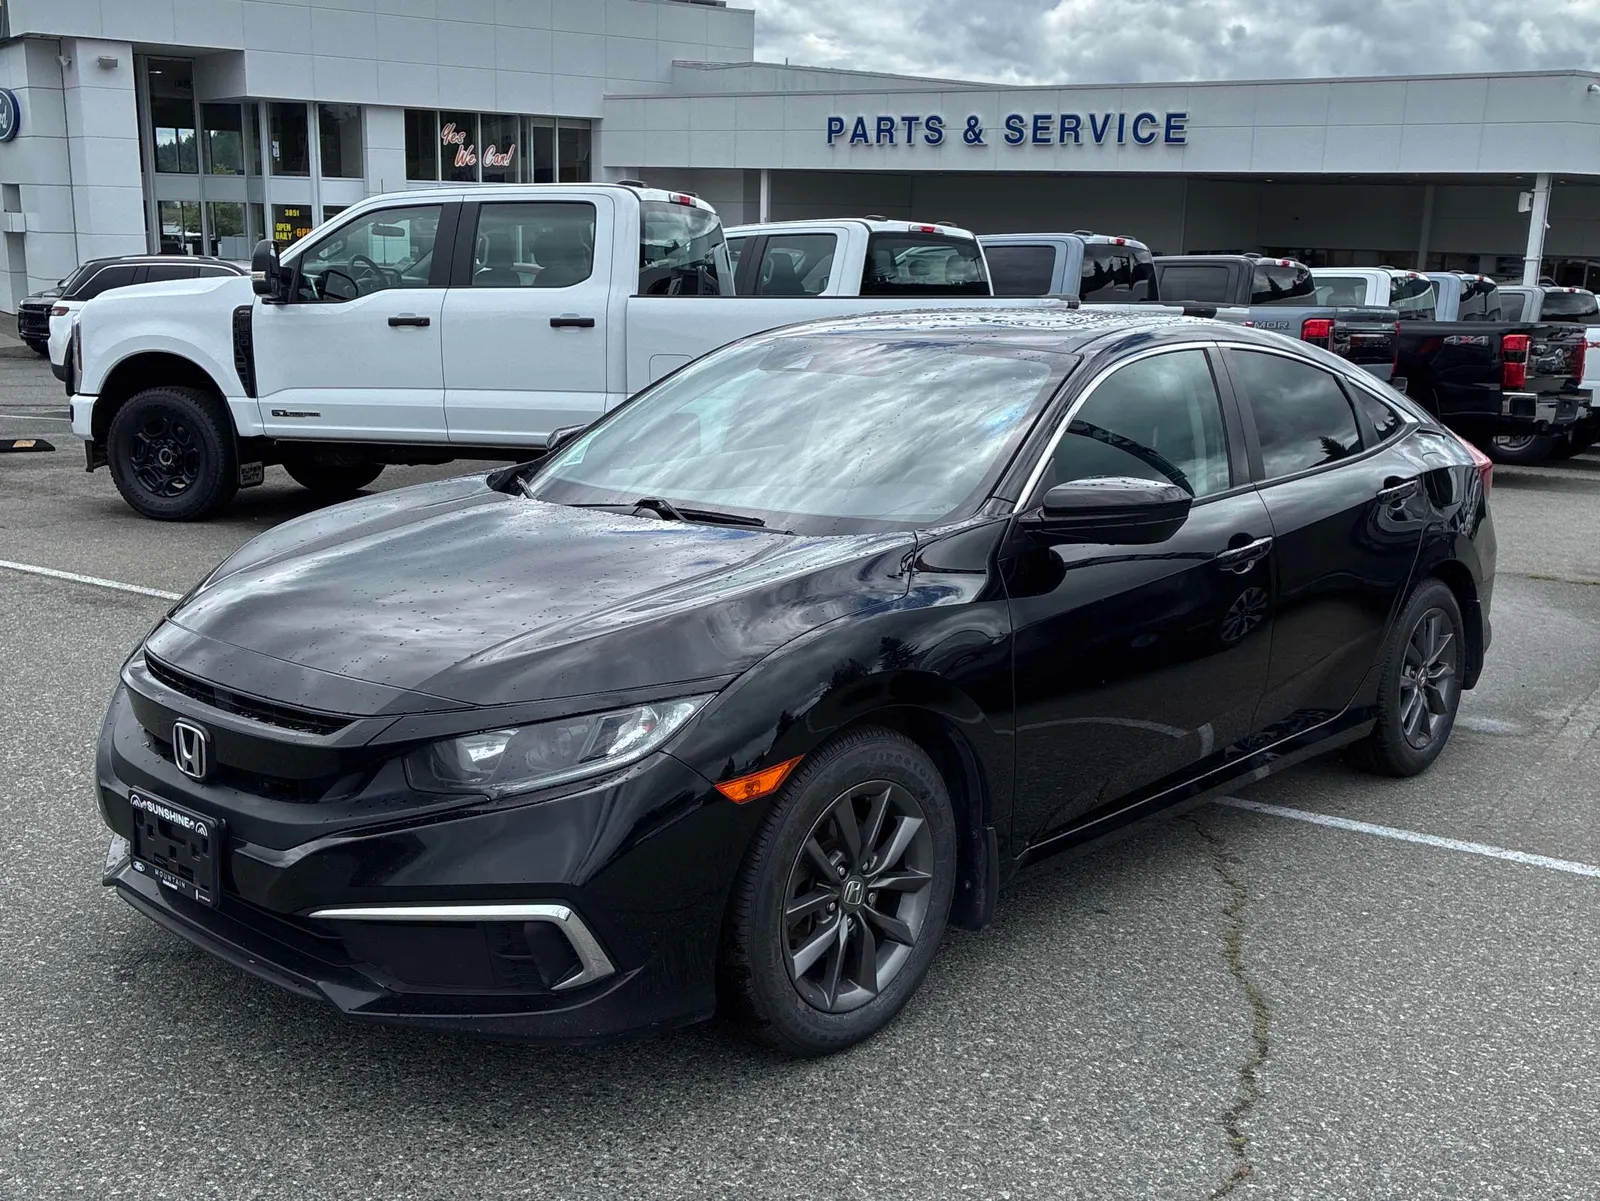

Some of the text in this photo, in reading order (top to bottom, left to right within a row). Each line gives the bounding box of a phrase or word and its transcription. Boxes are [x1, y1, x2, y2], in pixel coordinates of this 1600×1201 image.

[441, 122, 466, 145] Yes
[826, 111, 1190, 147] PARTS & SERVICE
[454, 144, 516, 167] We Can!
[284, 208, 300, 217] 3851
[275, 222, 291, 231] OPEN
[146, 801, 190, 829] SUNSHINE
[154, 868, 186, 889] MOUNTAIN
